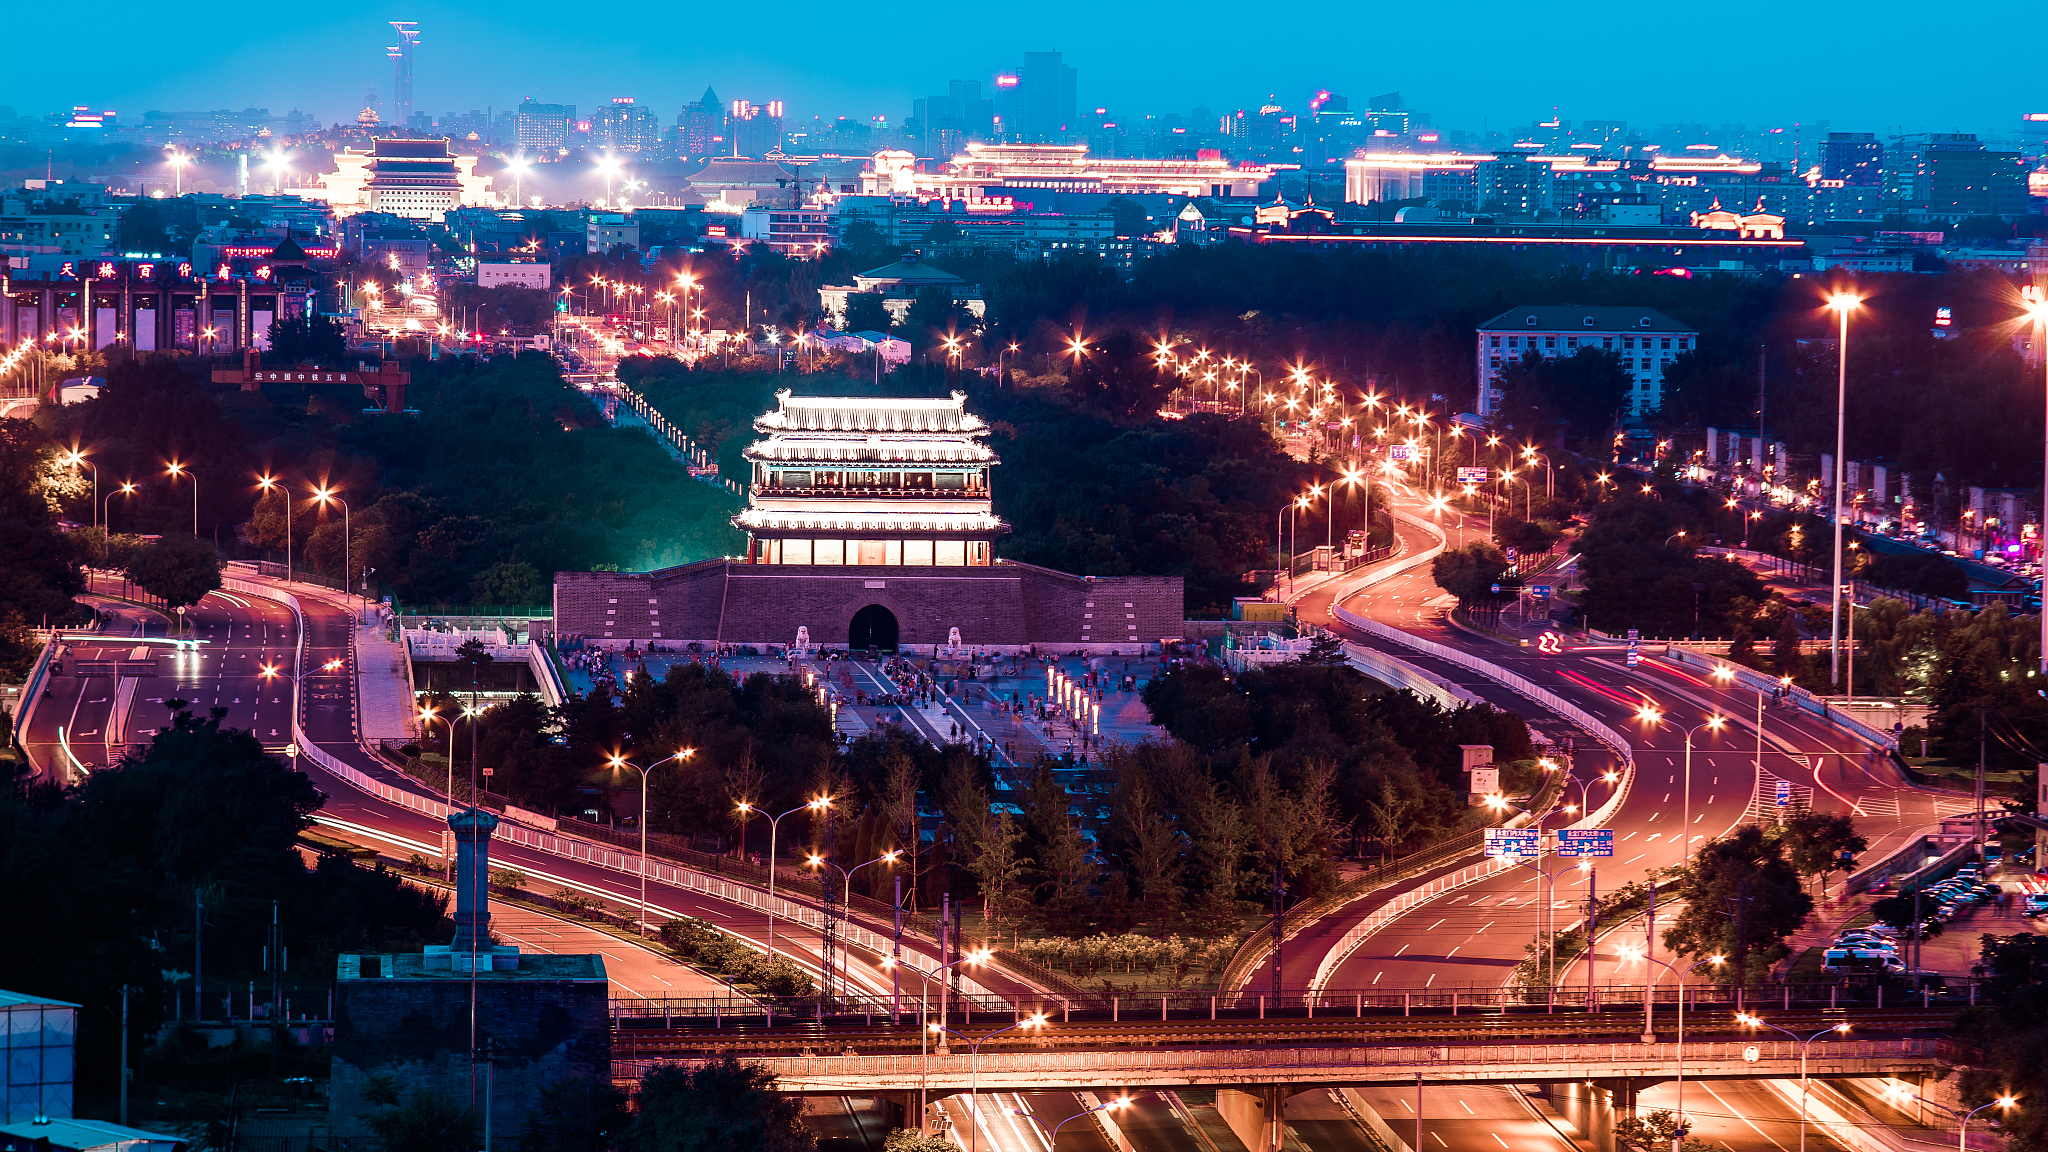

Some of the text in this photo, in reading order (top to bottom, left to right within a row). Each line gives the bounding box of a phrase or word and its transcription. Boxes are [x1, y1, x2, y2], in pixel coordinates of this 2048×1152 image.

[59, 262, 272, 280] 天桥百货商场
[269, 372, 347, 382] 中国中铁五局
